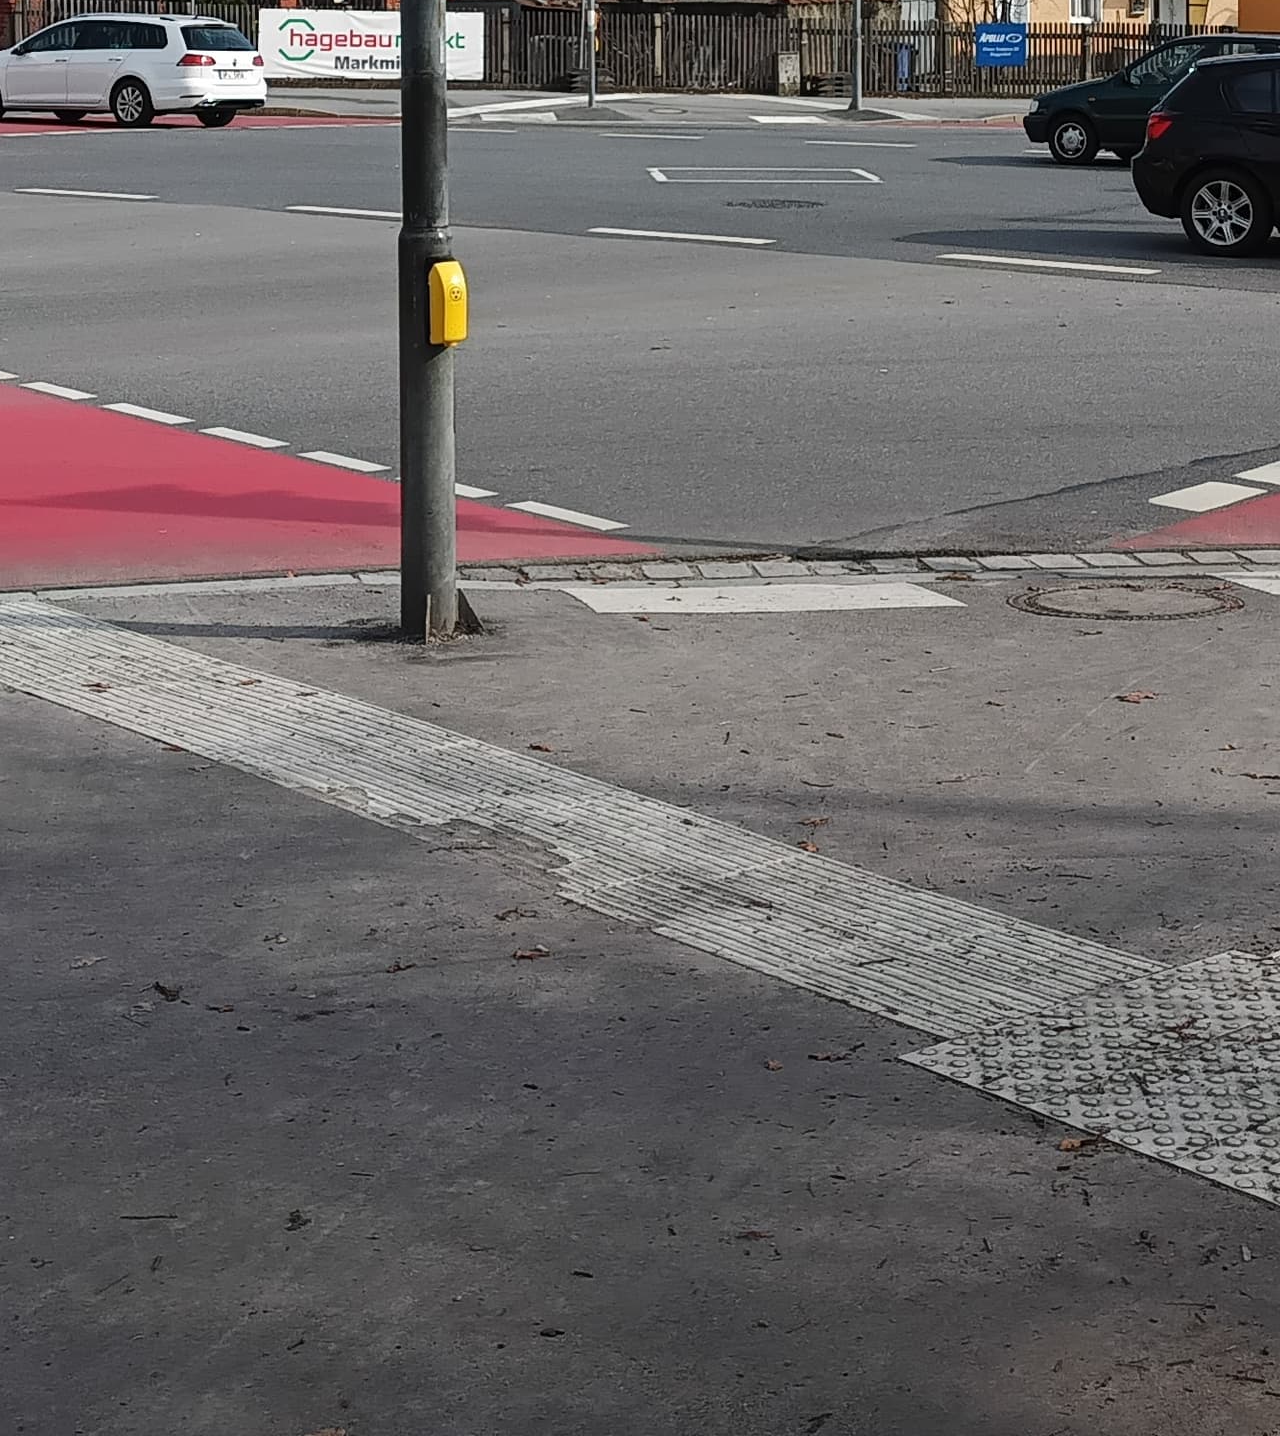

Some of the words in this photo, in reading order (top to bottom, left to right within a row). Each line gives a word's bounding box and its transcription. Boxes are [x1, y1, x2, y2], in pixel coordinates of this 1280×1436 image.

[290, 28, 465, 52] hagebaukt
[979, 33, 1005, 43] APOLLO
[334, 56, 401, 71] Markmi
